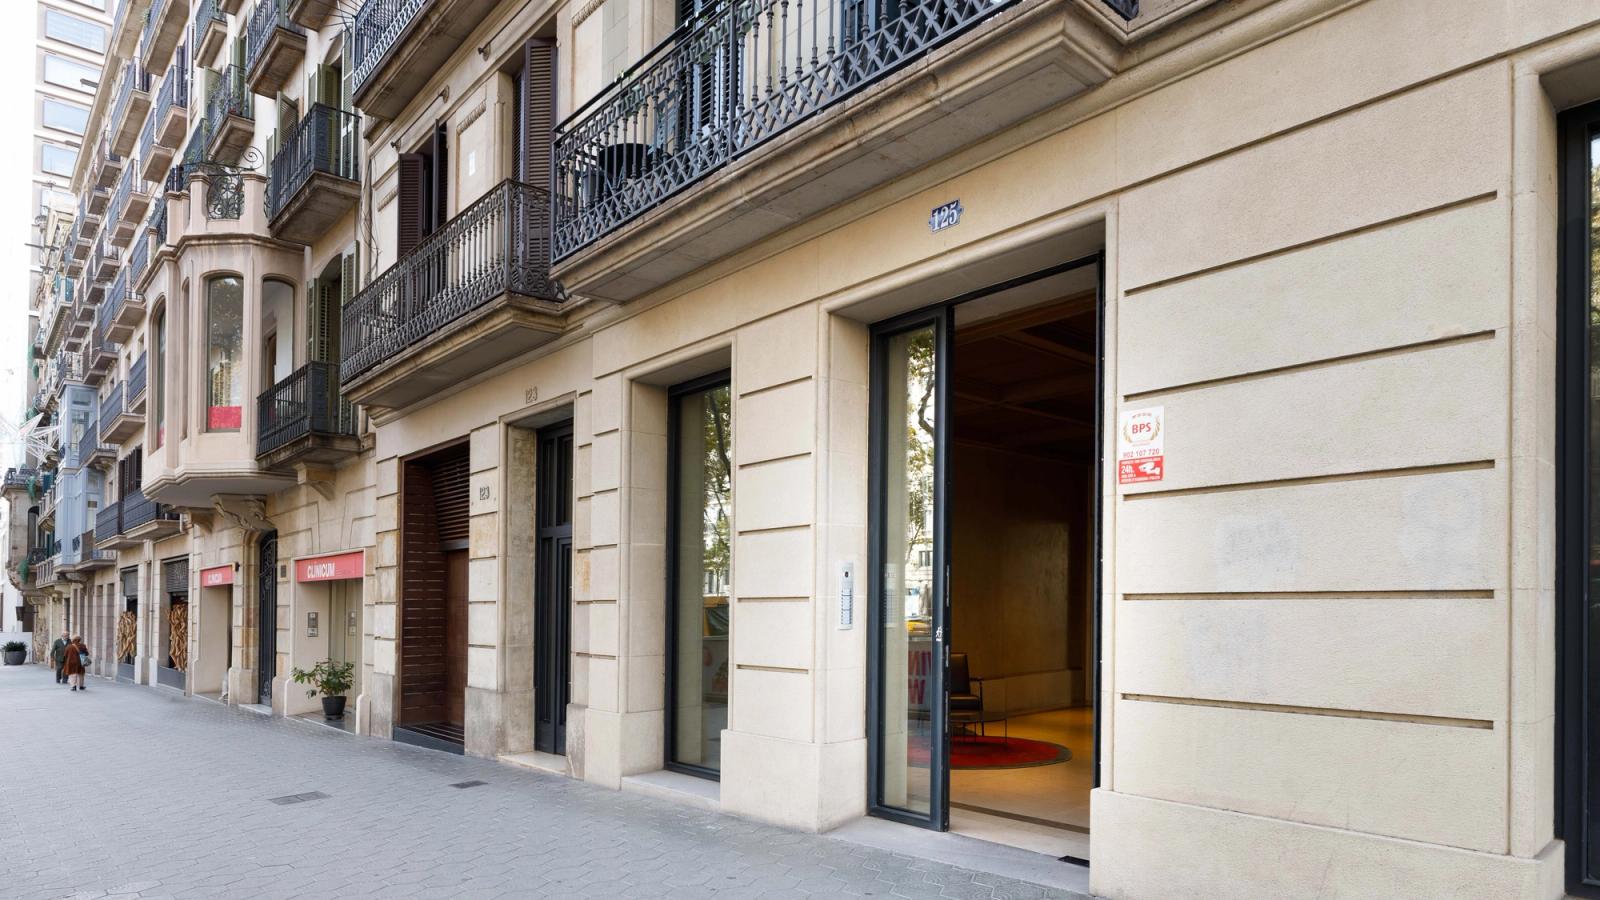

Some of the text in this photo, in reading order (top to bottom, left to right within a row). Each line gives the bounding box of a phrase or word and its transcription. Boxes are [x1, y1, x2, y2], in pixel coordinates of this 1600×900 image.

[931, 201, 958, 231] 125
[525, 386, 538, 404] 123
[1131, 422, 1152, 434] BPS
[1136, 449, 1147, 457] 107
[1148, 448, 1160, 456] 720
[479, 486, 490, 500] 123
[307, 562, 336, 578] CLINICUM
